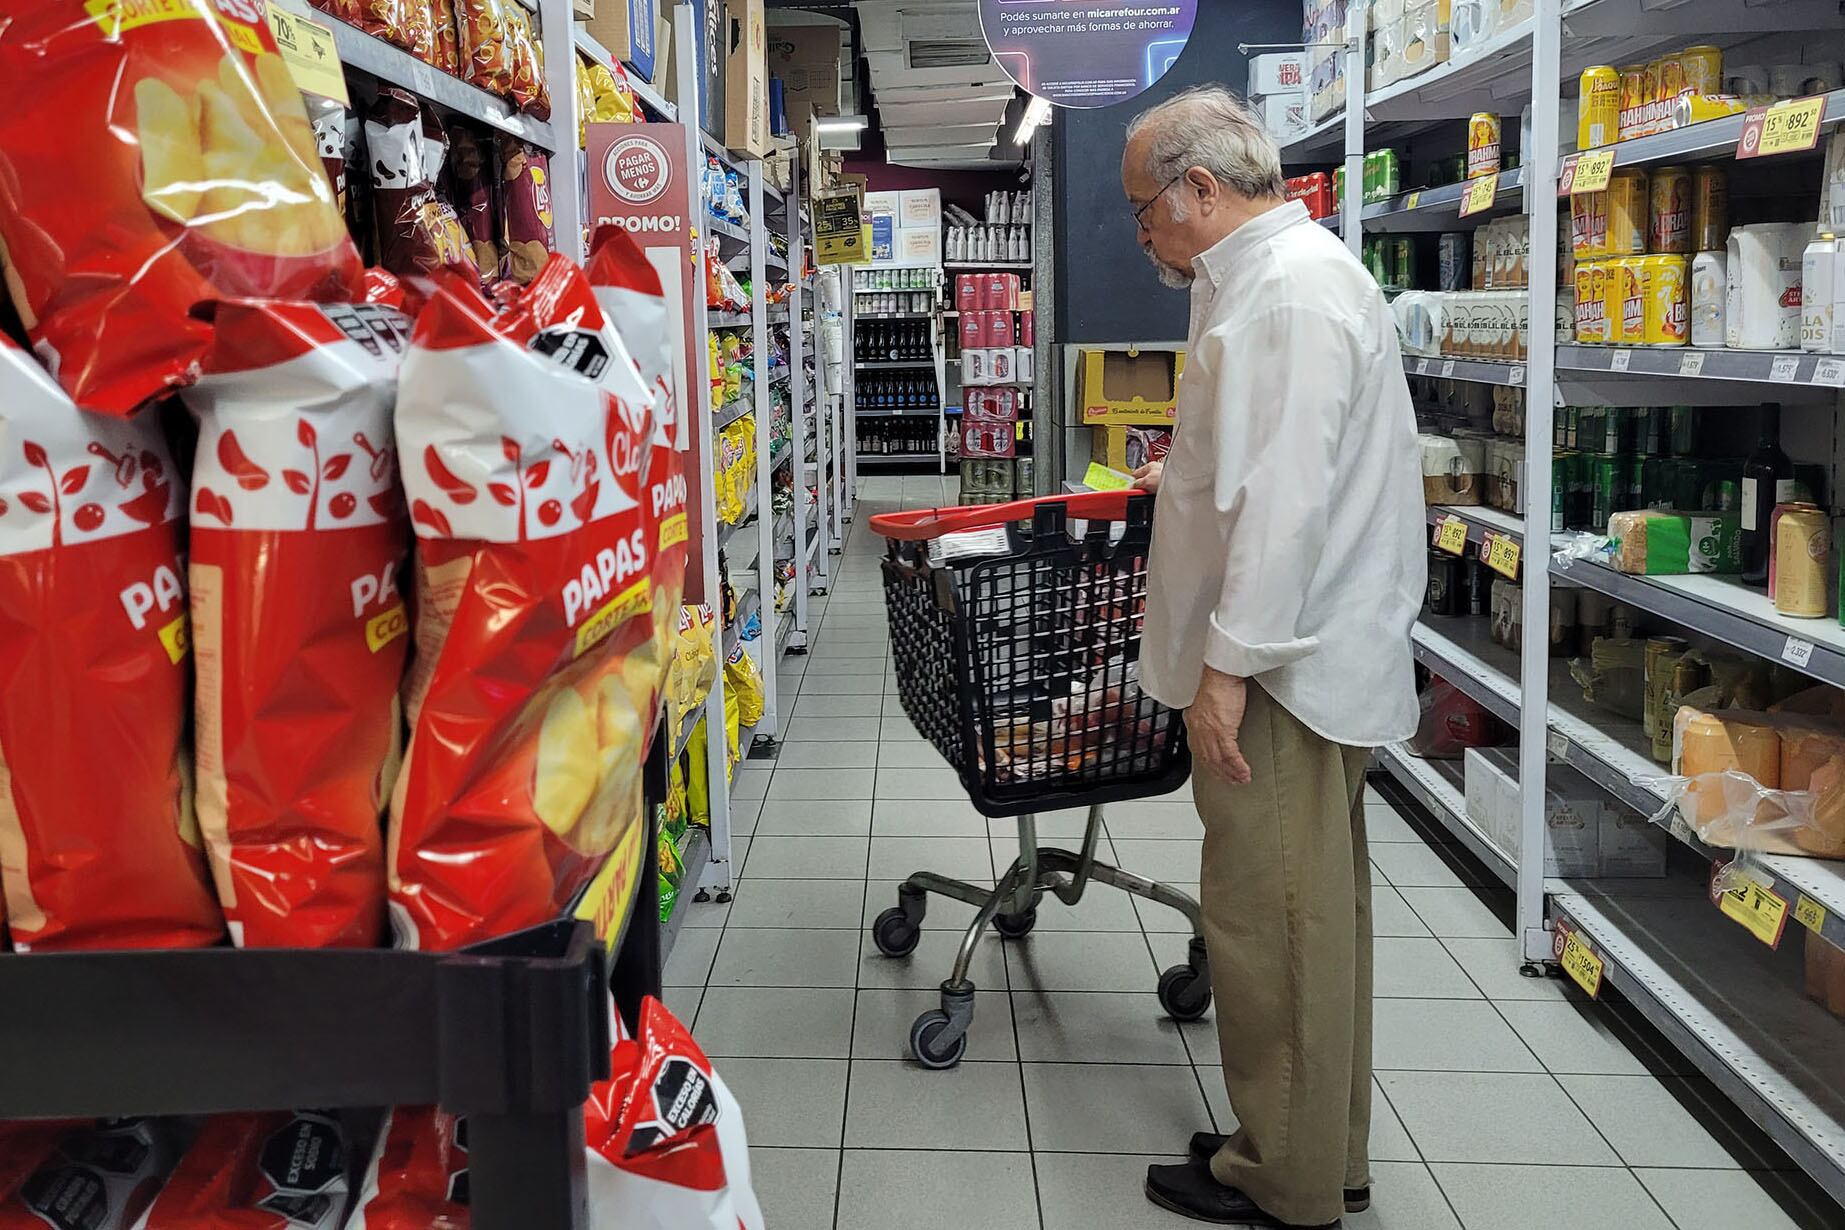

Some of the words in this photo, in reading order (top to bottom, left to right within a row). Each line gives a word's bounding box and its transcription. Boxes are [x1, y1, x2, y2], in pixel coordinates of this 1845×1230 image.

[1000, 11, 1030, 22] Podés
[1032, 10, 1070, 20] sumarte
[1072, 11, 1085, 19] en
[1087, 7, 1180, 18] micarrefour.com.ar
[1003, 27, 1009, 36] y
[1012, 24, 1065, 35] aprovechar
[1067, 22, 1087, 32] más
[1089, 20, 1121, 31] formas
[1123, 20, 1136, 30] de
[1138, 18, 1174, 29] ahorrar.
[619, 152, 652, 169] PAGAR
[620, 162, 656, 180] MENOS
[562, 528, 646, 628] PAPAS
[667, 1080, 692, 1124] EXCESO
[287, 1138, 307, 1185] EXCESO
